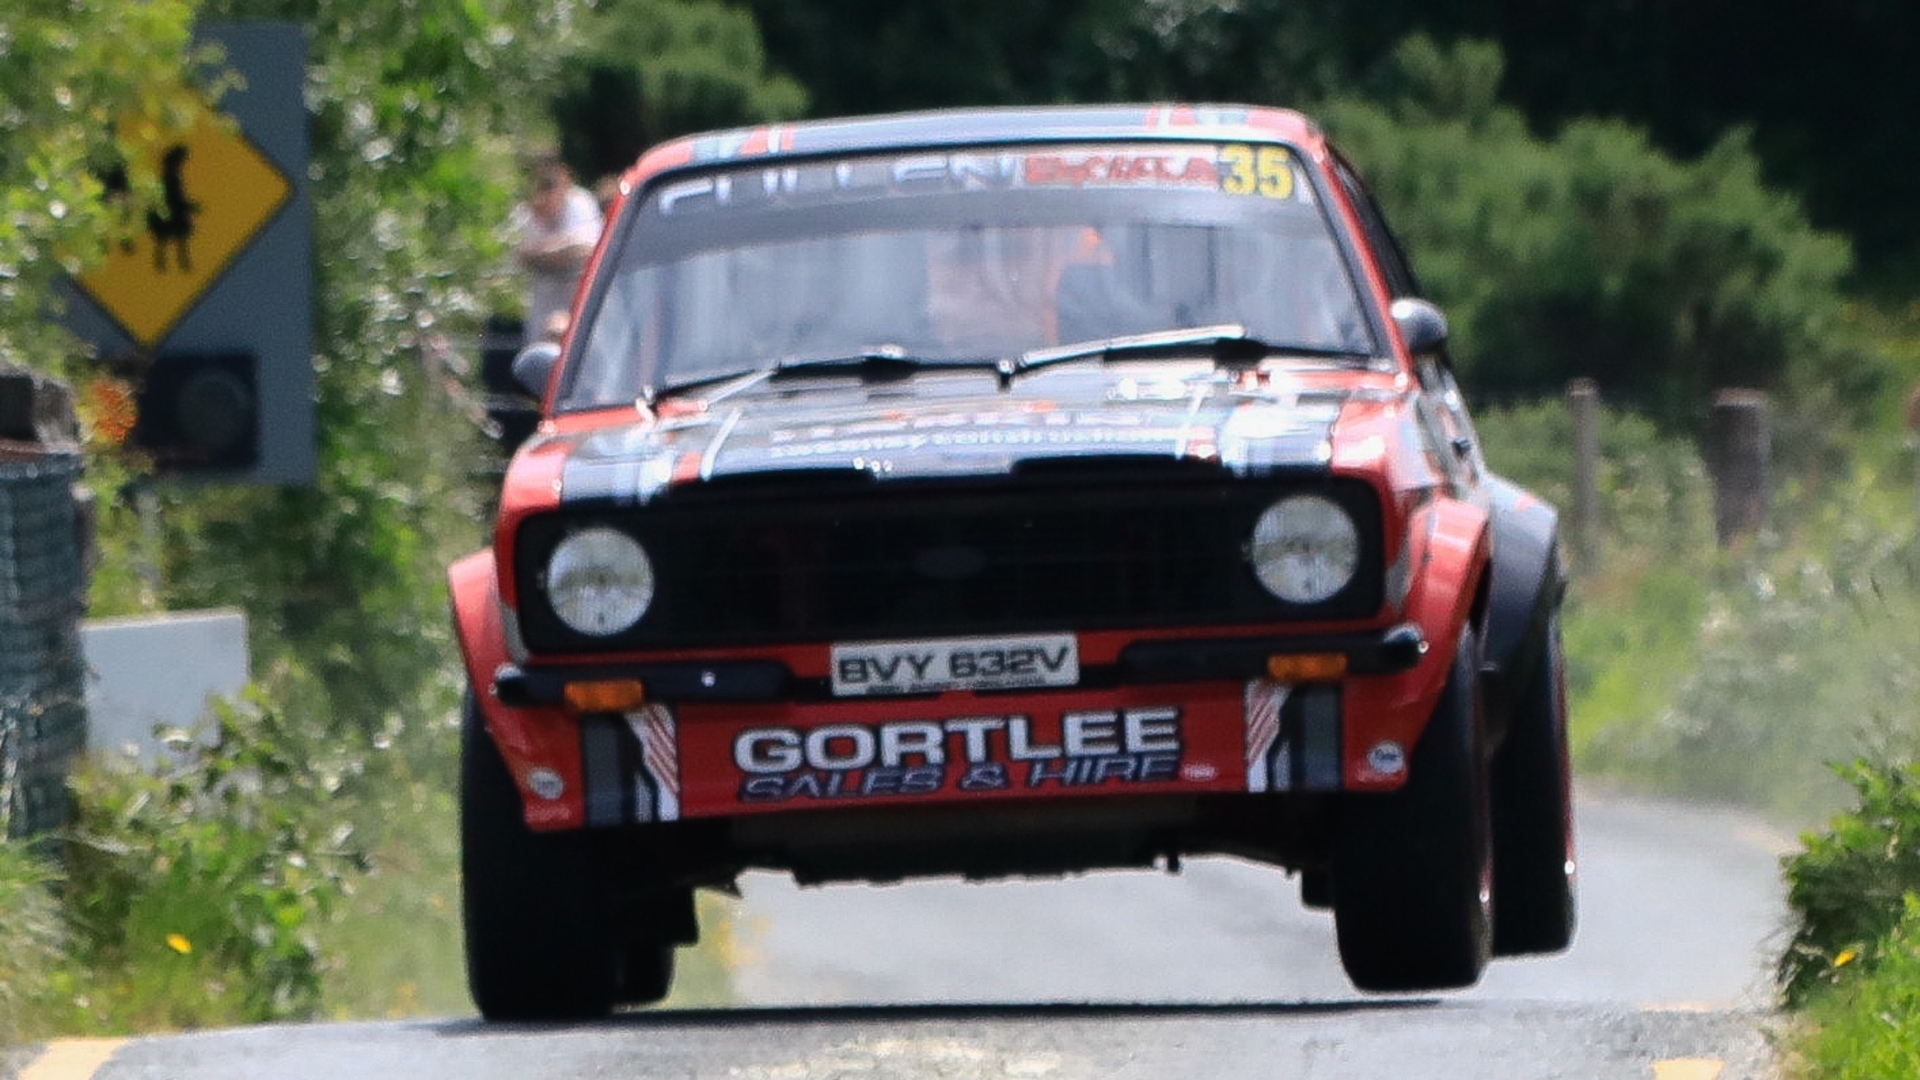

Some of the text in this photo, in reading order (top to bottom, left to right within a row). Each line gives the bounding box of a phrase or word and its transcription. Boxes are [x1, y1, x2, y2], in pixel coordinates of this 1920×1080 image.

[1221, 144, 1294, 199] 35
[838, 648, 1069, 684] BVY 632V
[733, 707, 1181, 774] GORTLEE
[741, 764, 945, 801] SALES
[958, 762, 1009, 790] &
[1027, 753, 1181, 788] HIRE
